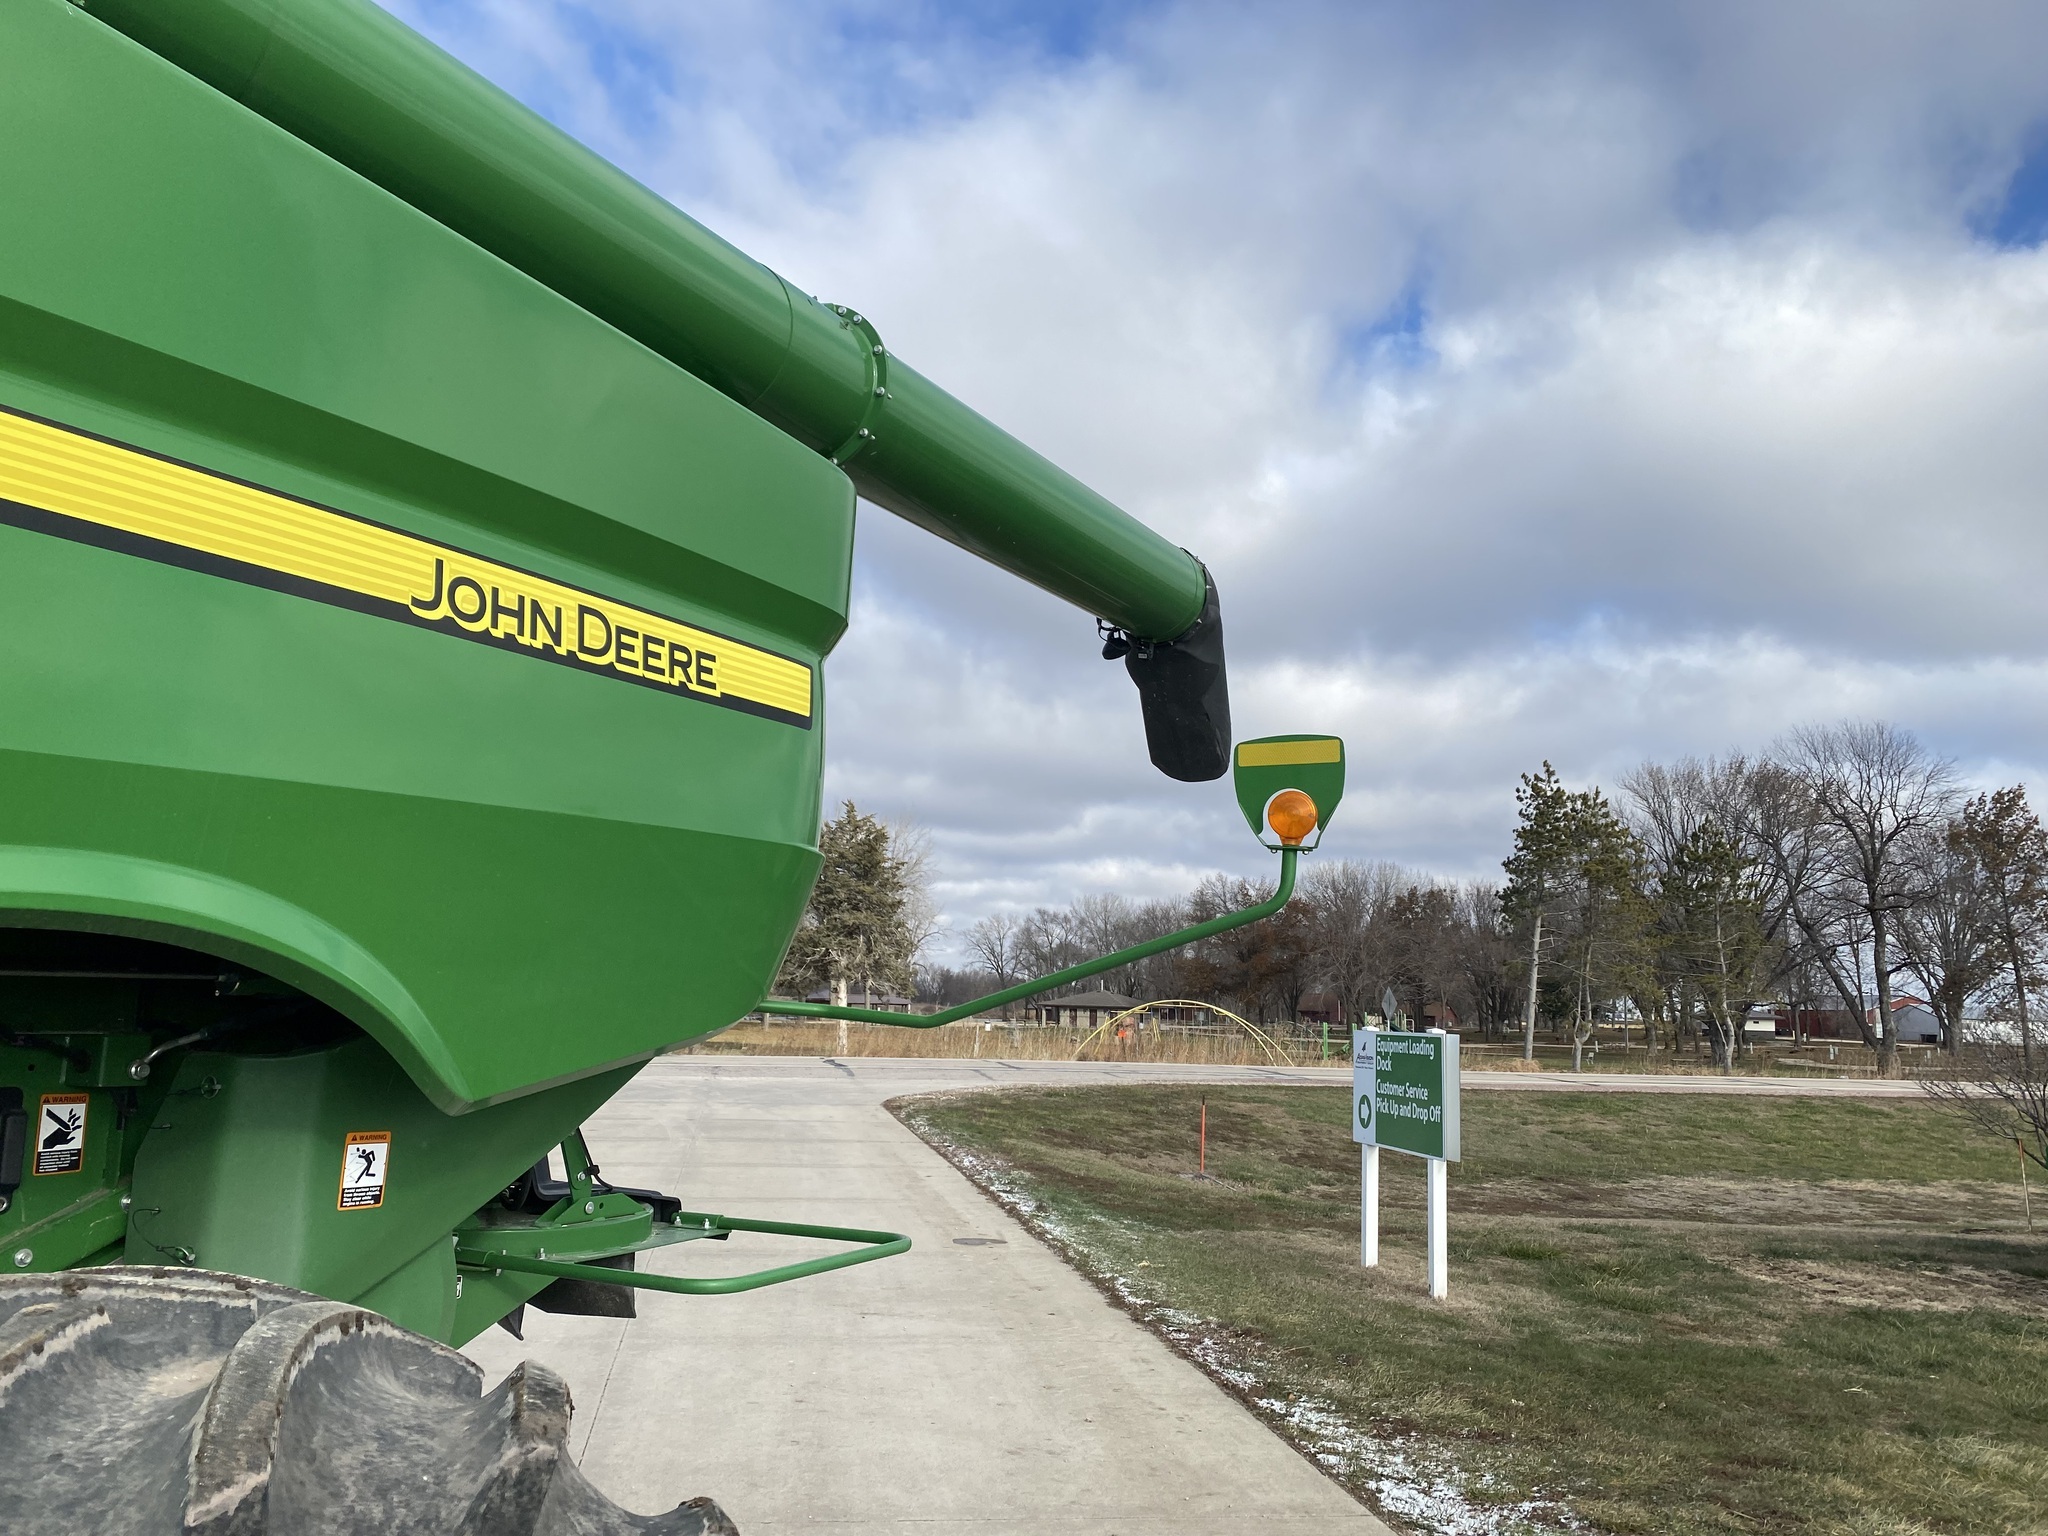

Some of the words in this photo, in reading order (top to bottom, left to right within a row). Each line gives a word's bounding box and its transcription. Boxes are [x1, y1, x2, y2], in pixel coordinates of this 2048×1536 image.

[411, 558, 562, 648] JOHN
[578, 603, 717, 691] DEERE
[1377, 1037, 1408, 1056] Equipment
[1409, 1039, 1434, 1060] Loading
[1377, 1056, 1392, 1071] Dock
[52, 1095, 87, 1103] WARNING
[1377, 1079, 1405, 1097] Customer
[1406, 1082, 1428, 1100] Service
[1377, 1097, 1389, 1114] Pick
[1390, 1100, 1399, 1119] Up
[1400, 1102, 1411, 1117] and
[1412, 1103, 1428, 1124] Drop
[1430, 1106, 1441, 1123] Off
